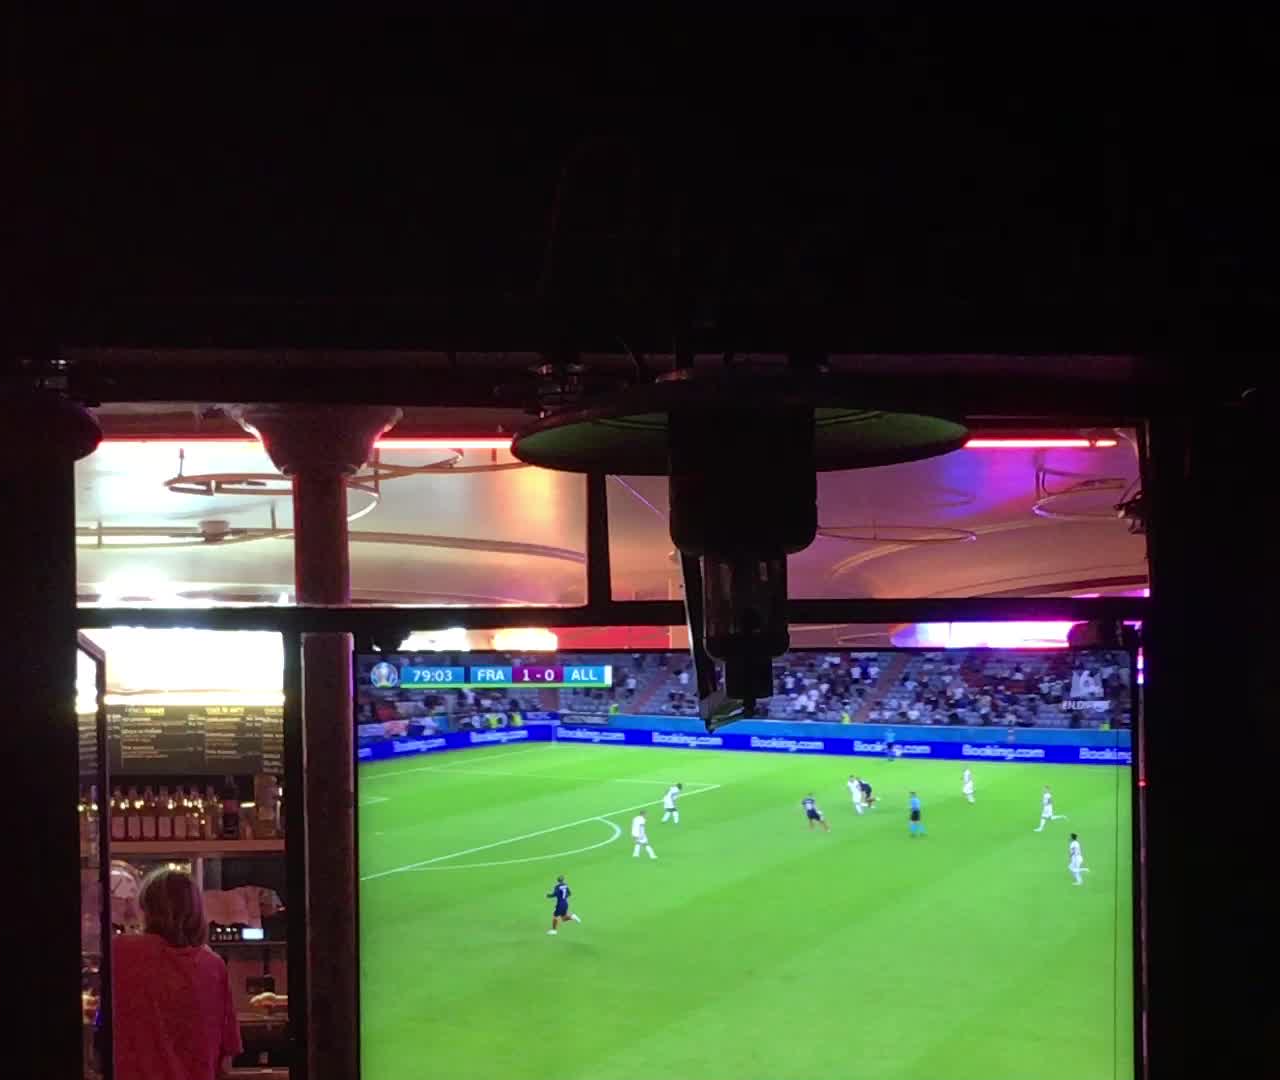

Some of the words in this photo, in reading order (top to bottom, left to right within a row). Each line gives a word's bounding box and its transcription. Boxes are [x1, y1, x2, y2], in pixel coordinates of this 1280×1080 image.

[413, 670, 453, 682] 79:03
[477, 670, 505, 681] FRA
[571, 670, 598, 681] ALL
[651, 731, 723, 748] Booking.com
[750, 736, 825, 752] Booking.com
[962, 744, 1046, 760] Booking.com
